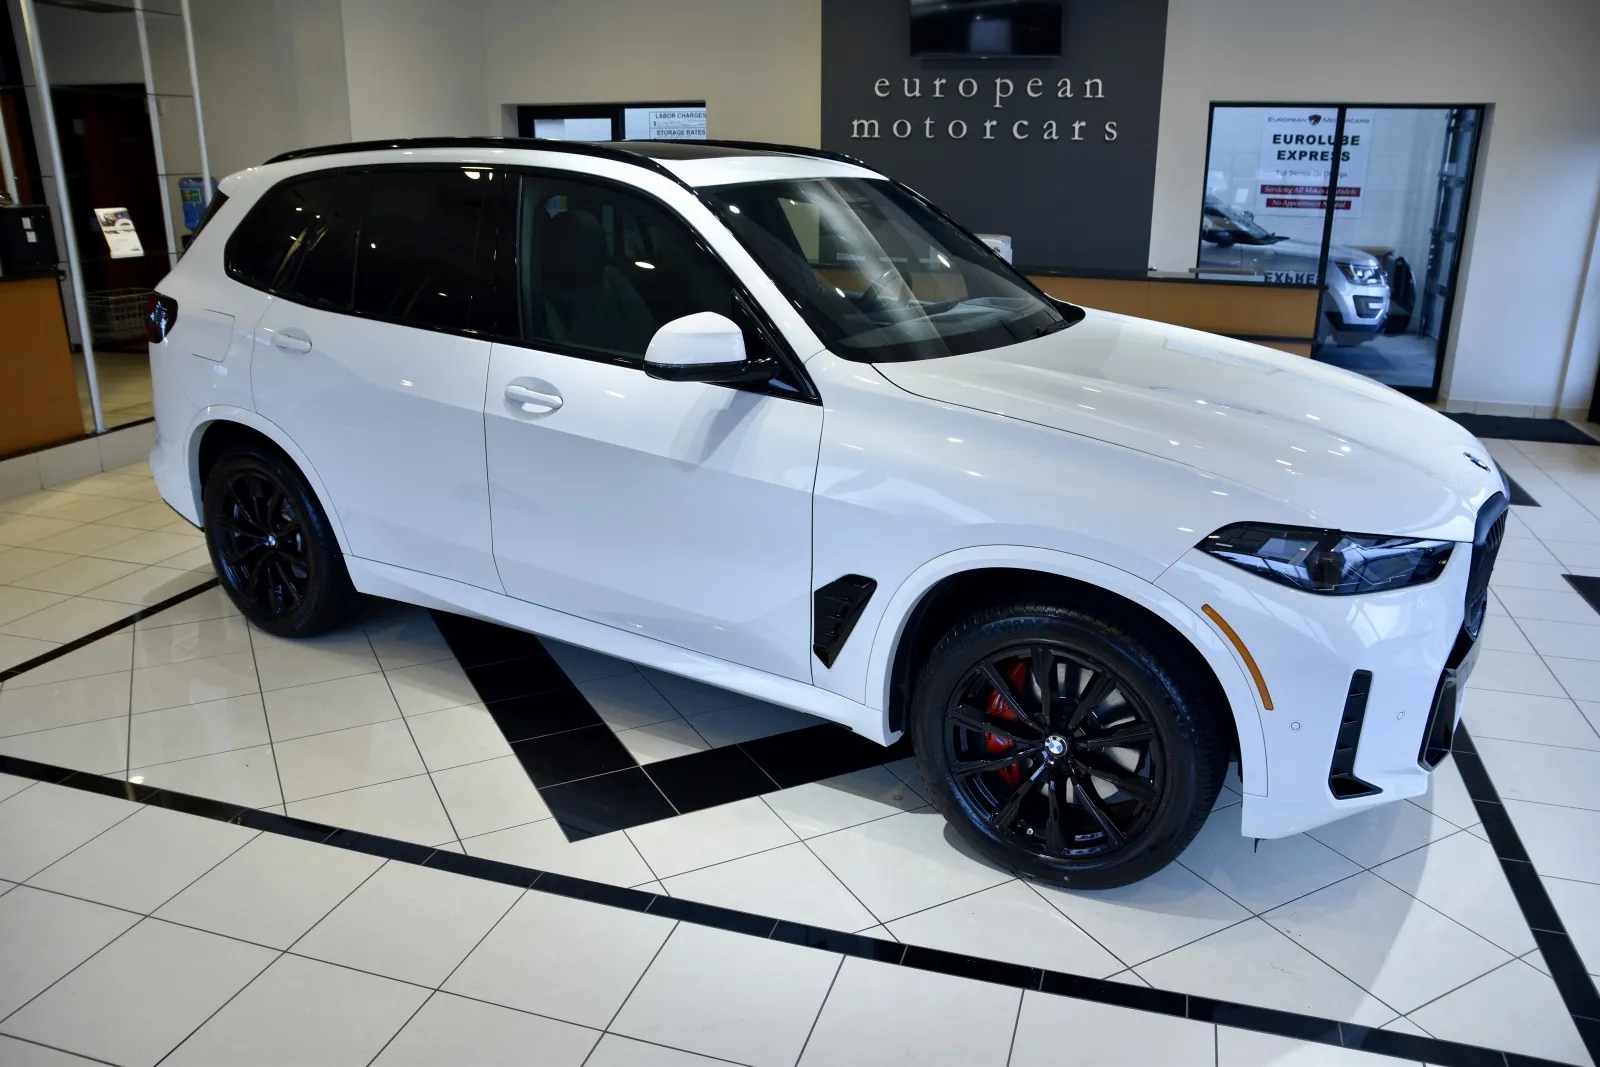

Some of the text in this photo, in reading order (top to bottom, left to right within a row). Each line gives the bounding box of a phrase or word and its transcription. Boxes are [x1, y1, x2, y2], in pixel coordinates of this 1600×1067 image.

[874, 76, 1105, 108] european
[851, 116, 1118, 141] motorcars
[1277, 150, 1351, 162] EXPRES
